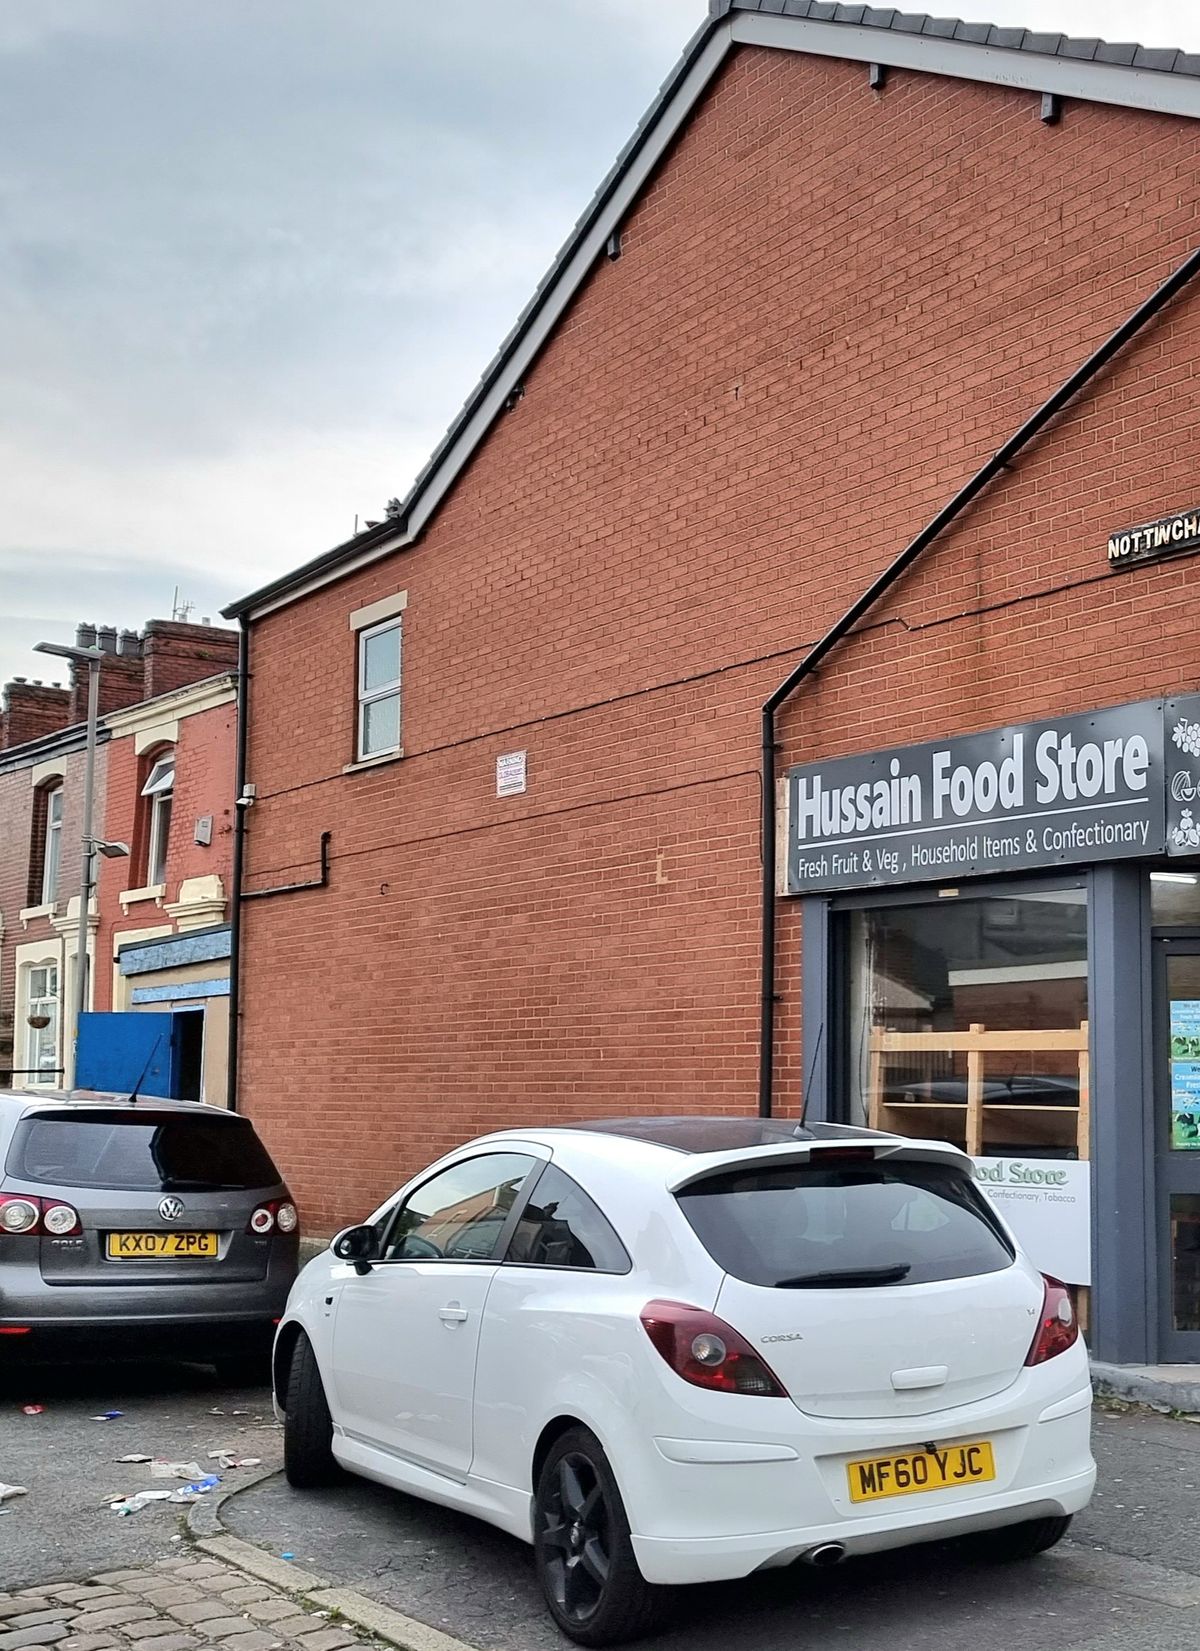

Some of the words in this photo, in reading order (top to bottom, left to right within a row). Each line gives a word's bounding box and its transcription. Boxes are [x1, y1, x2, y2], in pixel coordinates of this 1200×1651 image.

[798, 758, 922, 840] Hussain
[933, 733, 1024, 819] Food
[1036, 730, 1149, 804] Store
[798, 854, 828, 879] Fresh
[832, 851, 858, 875] Fruit
[862, 849, 872, 872] &
[911, 836, 978, 867] Household
[983, 835, 1020, 859] Items
[1025, 828, 1038, 853] &
[1042, 819, 1150, 851] Confectionary
[1008, 1161, 1069, 1186] Store
[1043, 1192, 1076, 1203] Tobacco
[120, 1235, 169, 1252] KX07
[174, 1234, 209, 1251] ZPG
[760, 1333, 803, 1344] CORSA
[858, 1455, 928, 1495] MF60
[934, 1447, 983, 1481] YJC
